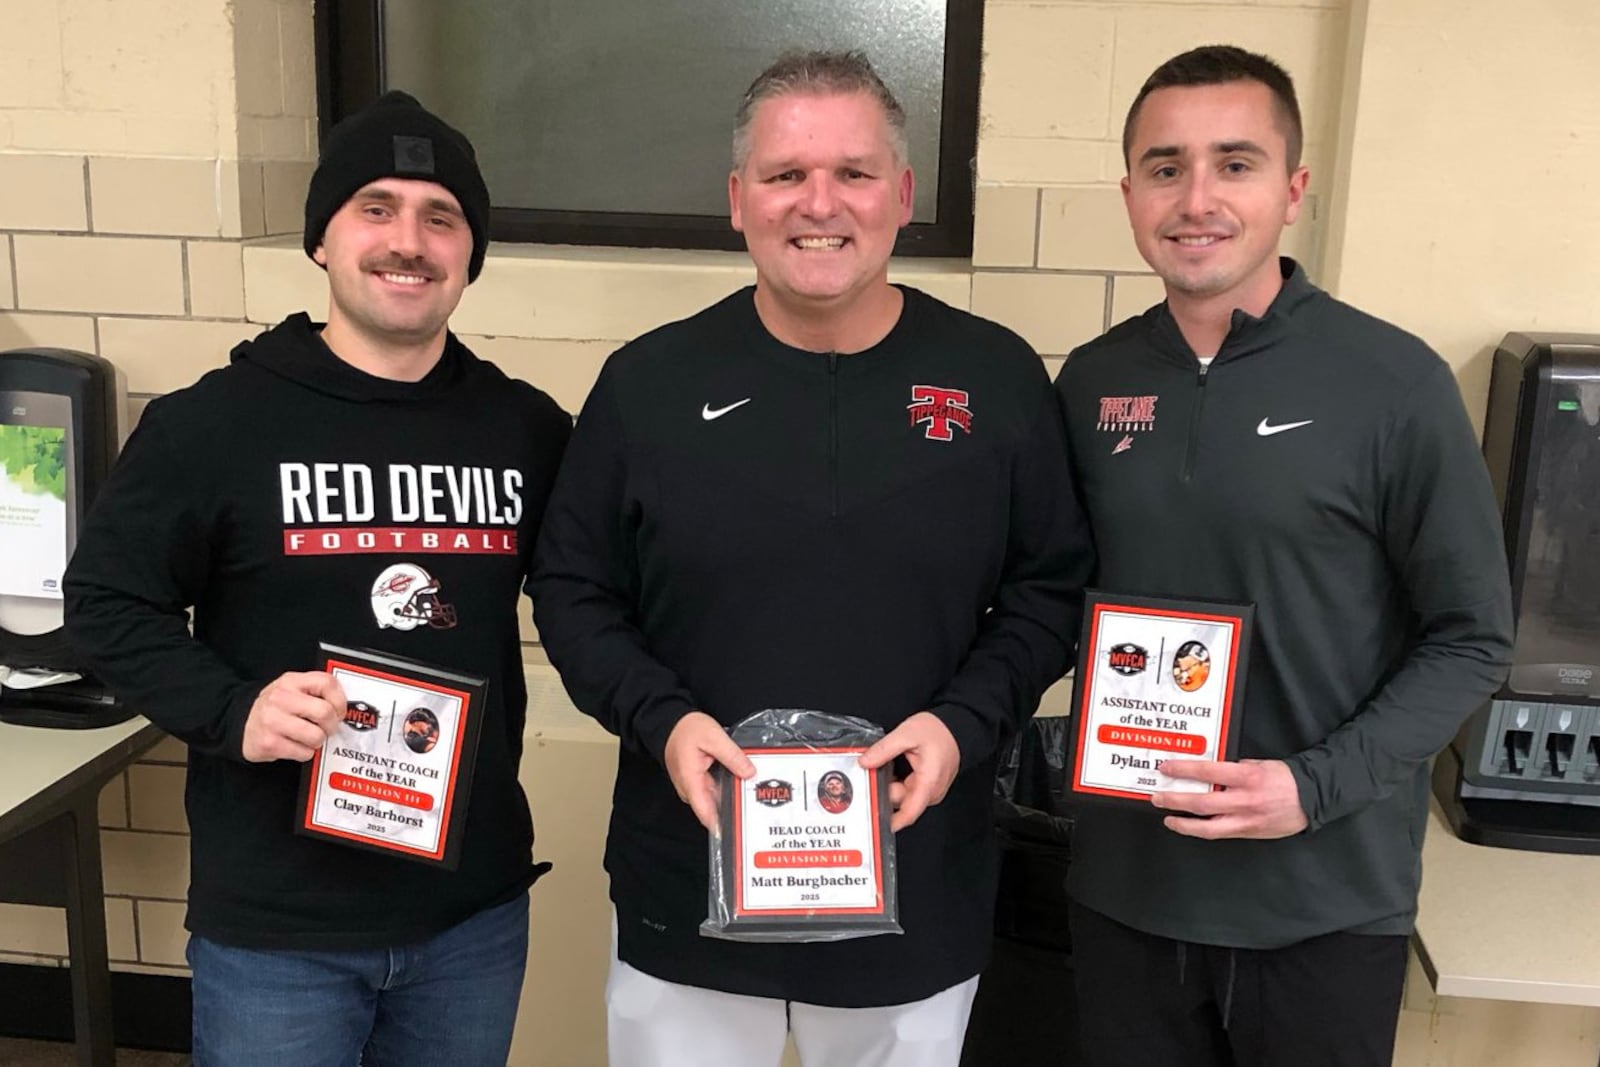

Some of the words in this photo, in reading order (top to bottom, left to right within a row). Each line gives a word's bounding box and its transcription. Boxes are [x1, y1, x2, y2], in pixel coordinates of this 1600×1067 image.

[1100, 395, 1158, 422] TIPPECANOE
[908, 403, 973, 434] TIPPECANOE
[279, 463, 375, 524] RED
[388, 464, 523, 525] DEVILS
[290, 532, 512, 550] FOOTBALL
[1111, 652, 1144, 668] MVFCA
[1101, 697, 1167, 713] ASSISTANT
[1169, 704, 1212, 718] COACH
[1120, 714, 1132, 724] of
[1134, 715, 1153, 727] the
[1156, 718, 1188, 731] YEAR
[1111, 730, 1172, 746] DIVISION
[1176, 739, 1193, 749] III
[333, 747, 397, 770] ASSISTANT
[399, 762, 440, 780] COACH
[1111, 753, 1150, 770] Dylan
[351, 765, 364, 776] of
[365, 767, 384, 781] the
[387, 773, 417, 788] YEAR
[1137, 777, 1157, 786] 2025
[342, 779, 401, 799] DIVISION
[404, 793, 421, 804] III
[758, 786, 790, 800] MVFCA
[333, 797, 364, 816] Clay
[365, 804, 424, 828] Barhorst
[367, 823, 386, 833] 2025
[769, 826, 803, 835] HEAD
[805, 825, 846, 835] COACH
[788, 839, 807, 848] the
[809, 839, 842, 848] YEAR
[767, 855, 828, 864] DIVISION
[832, 855, 849, 864] III
[751, 876, 783, 888] Matt
[786, 874, 869, 890] Burgbacher
[800, 893, 820, 901] 2025
